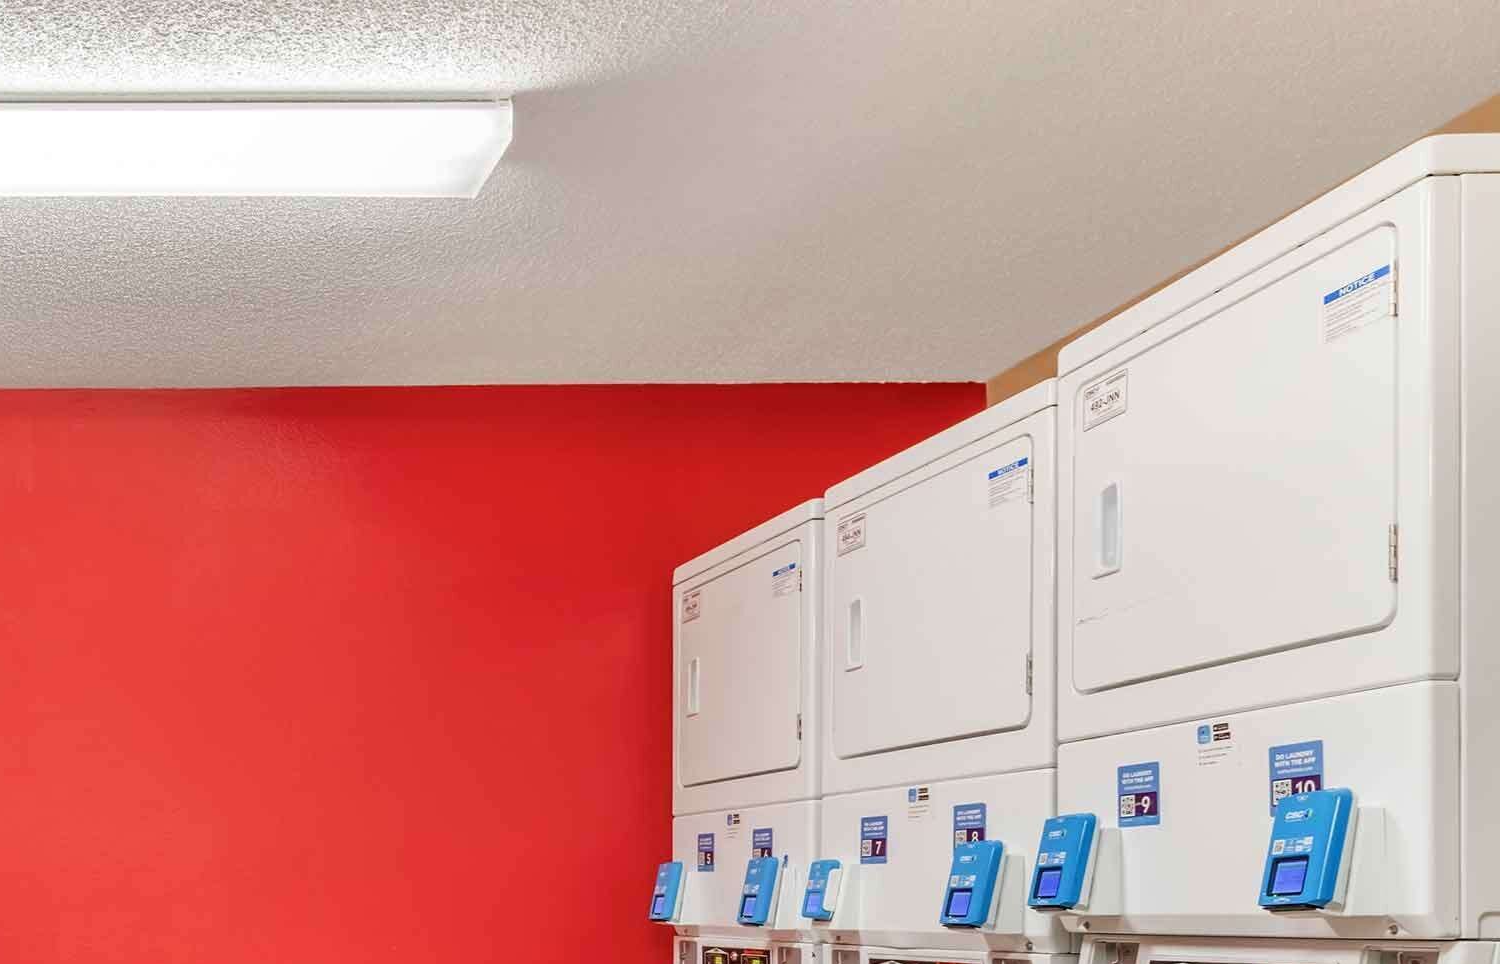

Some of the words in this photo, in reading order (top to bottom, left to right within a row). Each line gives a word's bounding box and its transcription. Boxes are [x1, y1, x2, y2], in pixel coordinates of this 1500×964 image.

[1339, 272, 1377, 296] NOTICE
[1295, 780, 1315, 794] 10
[1142, 796, 1150, 813] 9
[876, 841, 882, 854] 7
